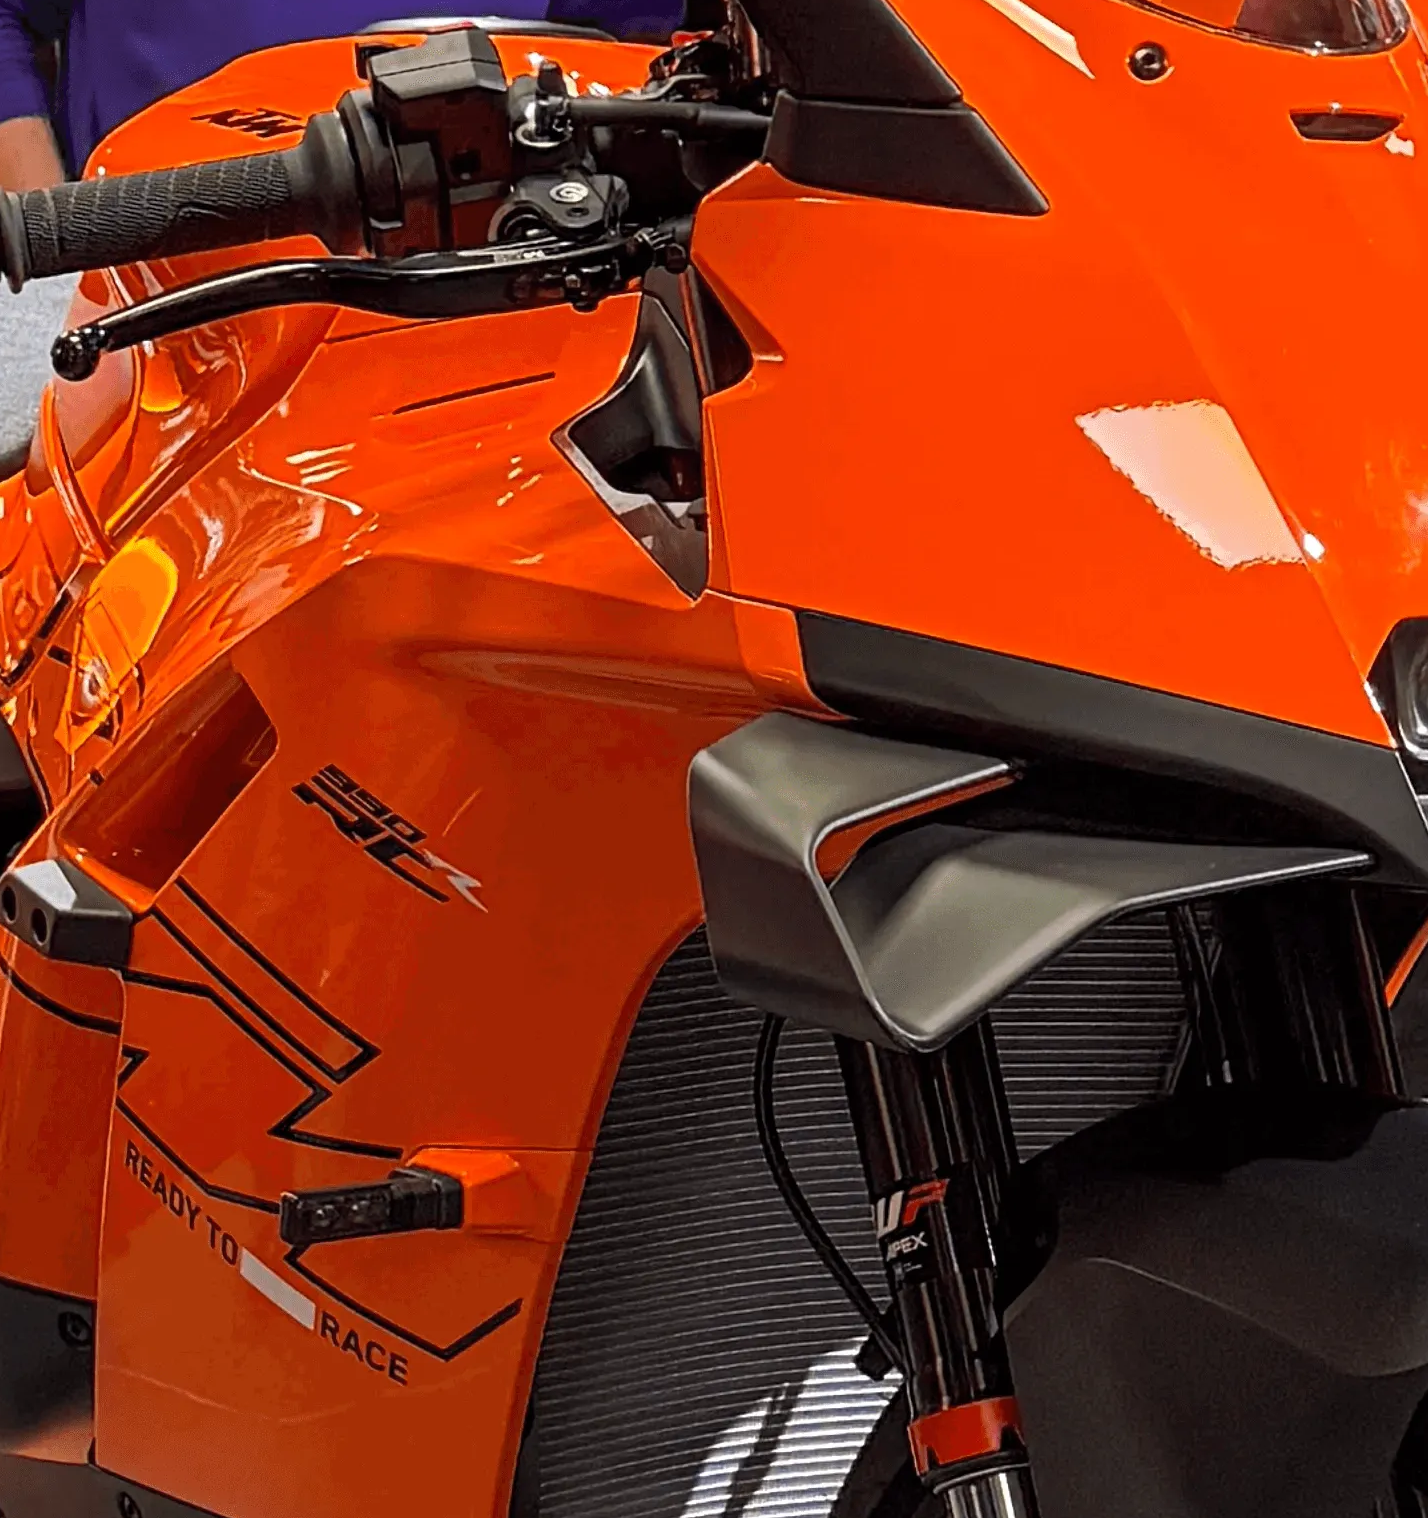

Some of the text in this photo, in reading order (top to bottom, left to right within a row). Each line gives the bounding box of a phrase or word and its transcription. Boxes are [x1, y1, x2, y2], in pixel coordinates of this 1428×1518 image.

[124, 1138, 409, 1387] READY TO RACE
